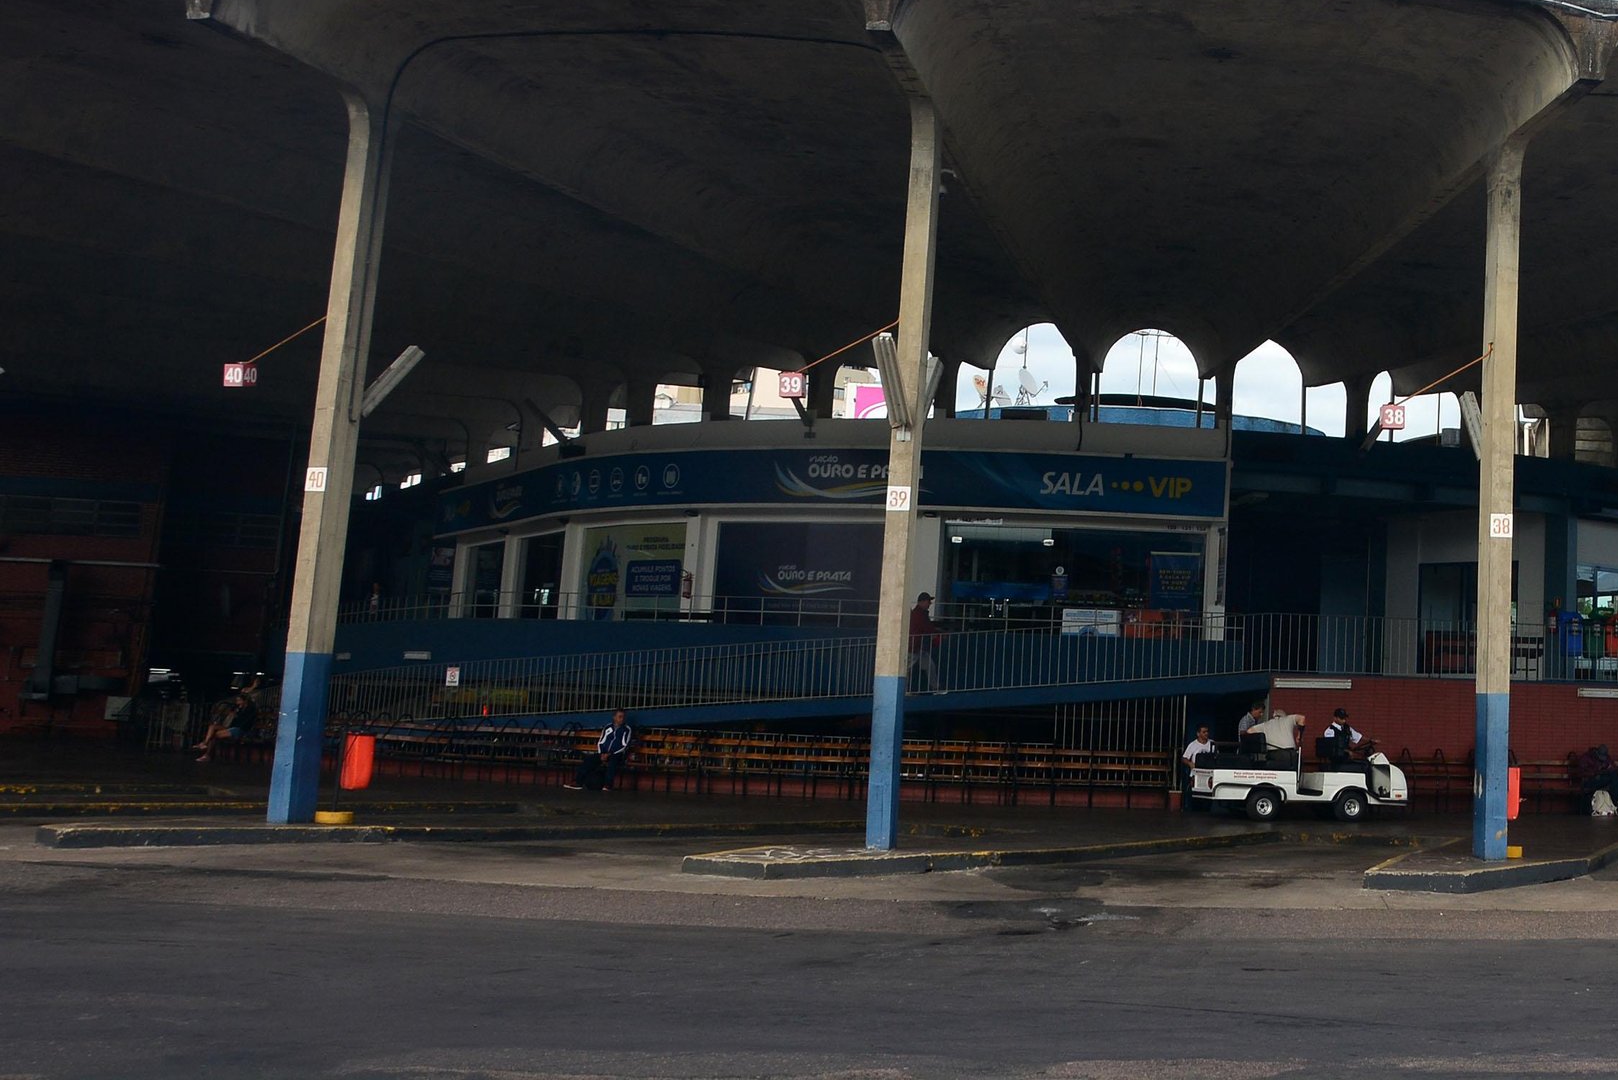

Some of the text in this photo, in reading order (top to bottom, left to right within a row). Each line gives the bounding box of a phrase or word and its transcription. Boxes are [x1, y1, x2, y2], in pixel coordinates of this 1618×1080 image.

[225, 367, 243, 383] 40
[244, 367, 257, 383] 40
[781, 376, 802, 393] 39
[1384, 408, 1404, 425] 38
[808, 464, 855, 478] OURO
[858, 465, 869, 478] E
[309, 471, 324, 488] 40
[1040, 471, 1193, 500] SALA VIP
[890, 490, 907, 508] 39
[1493, 518, 1510, 534] 38
[778, 570, 852, 582] OURO E PRATA
